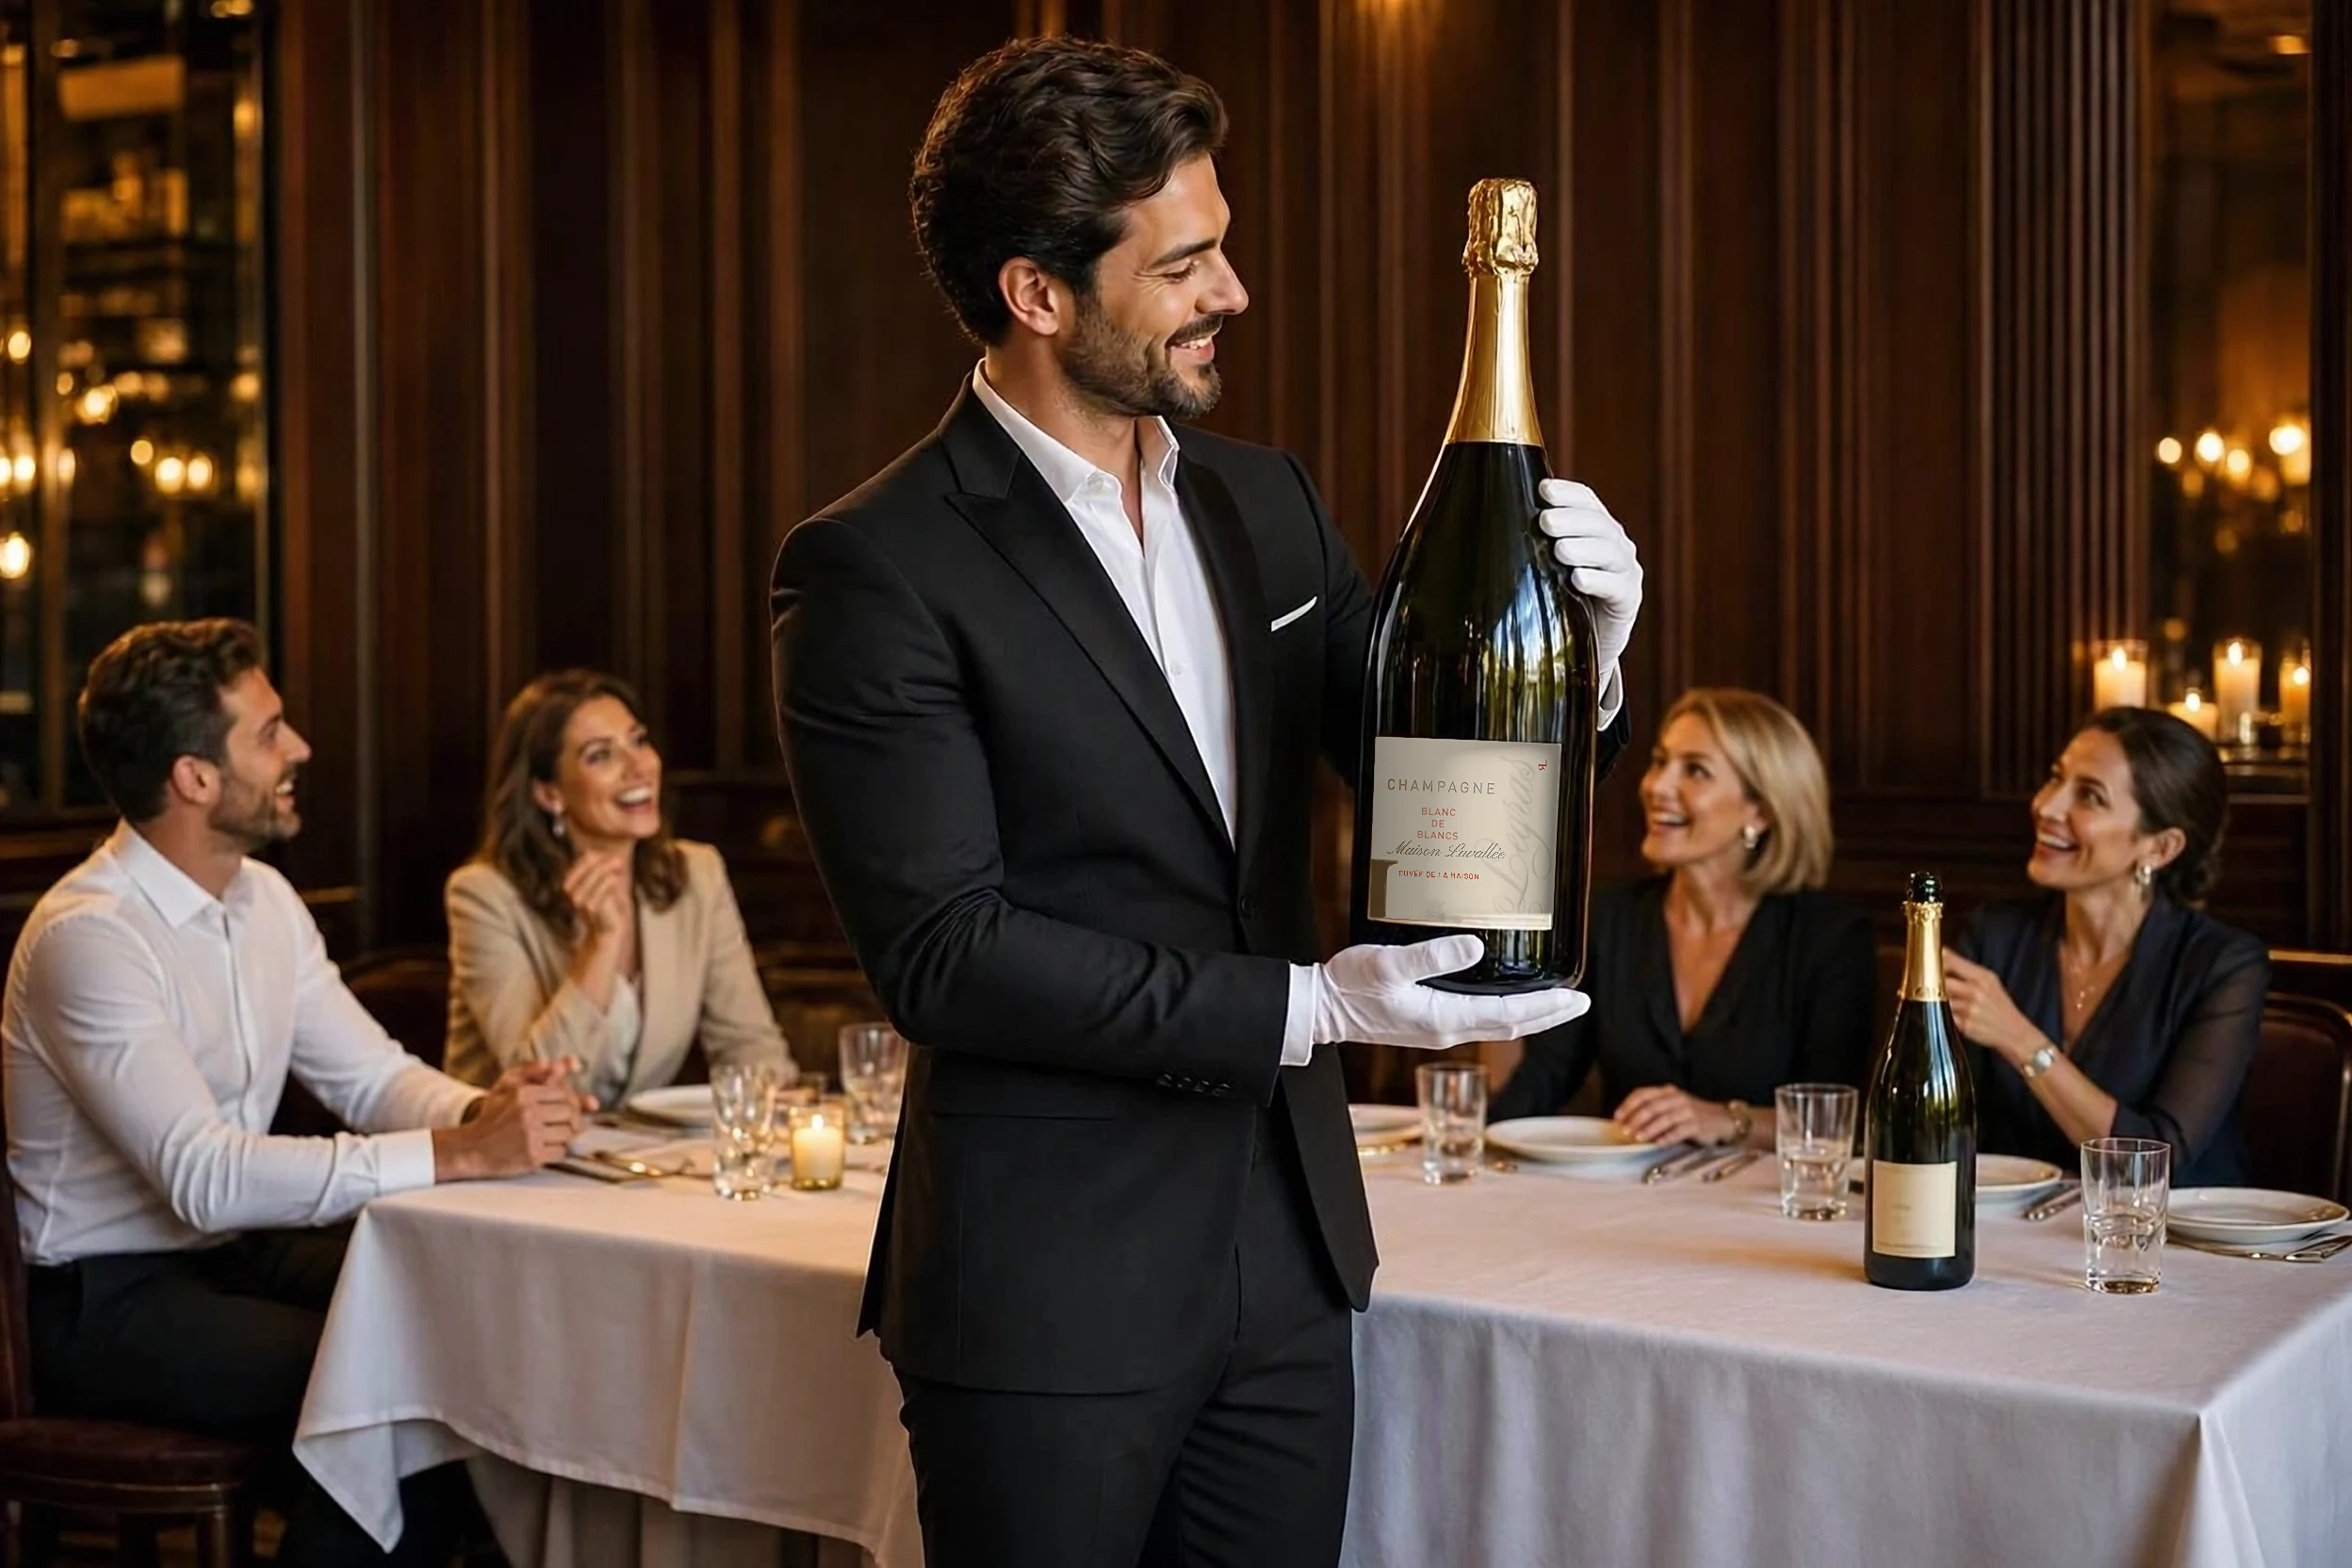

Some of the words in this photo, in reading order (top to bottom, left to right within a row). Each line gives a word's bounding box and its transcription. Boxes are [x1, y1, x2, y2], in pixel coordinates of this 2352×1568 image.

[1387, 778, 1495, 794] CHAMPAGNE
[1421, 807, 1456, 817] BLANC
[1431, 819, 1445, 828] DE
[1417, 830, 1459, 841] BLANCS
[1386, 840, 1442, 857] Maison
